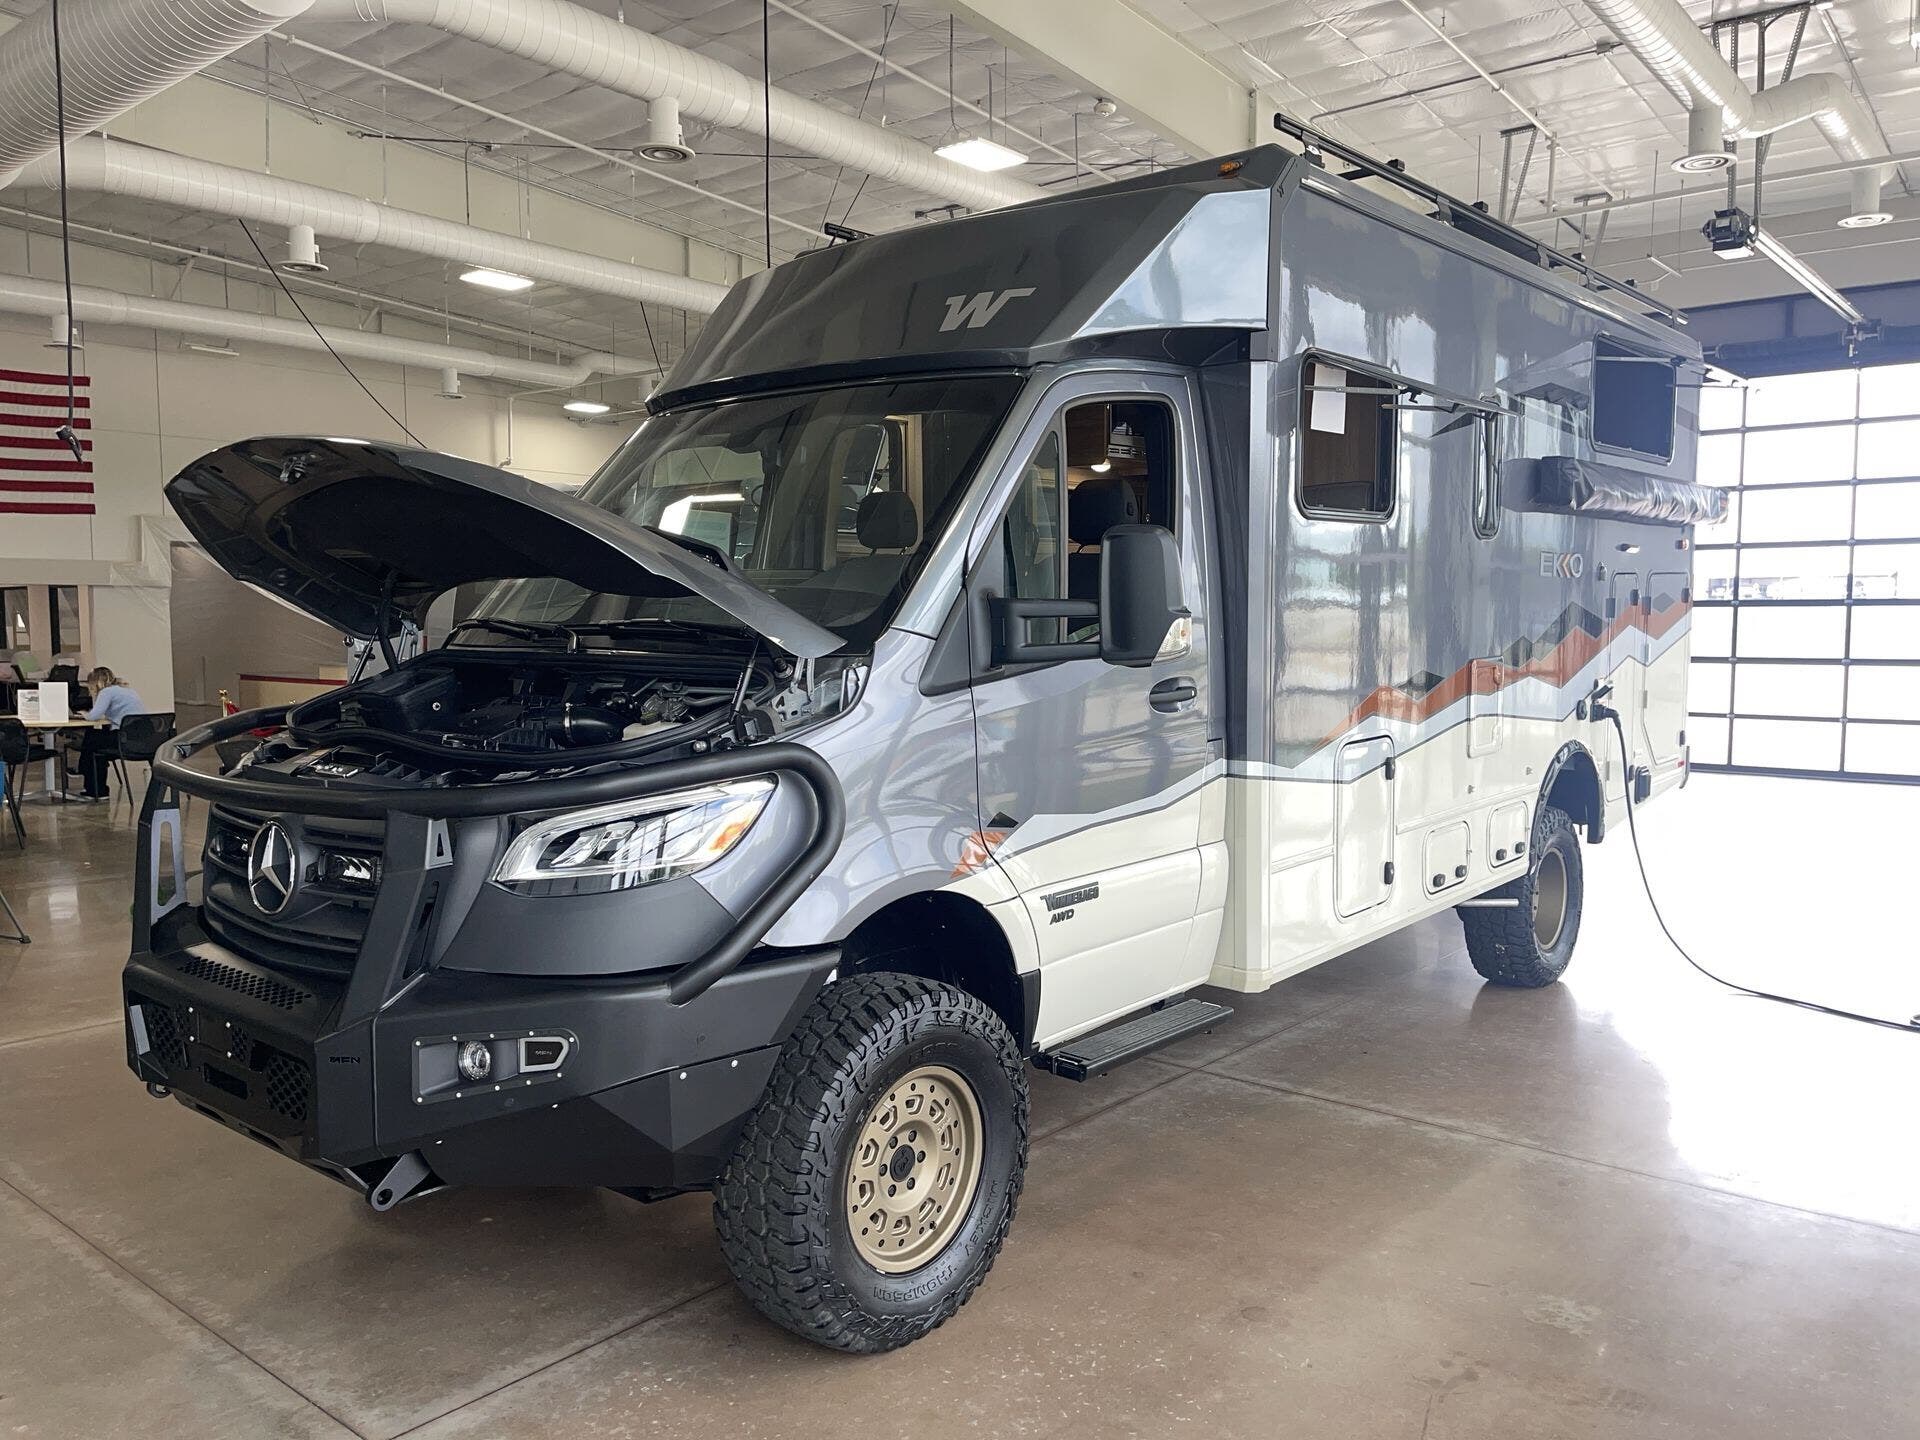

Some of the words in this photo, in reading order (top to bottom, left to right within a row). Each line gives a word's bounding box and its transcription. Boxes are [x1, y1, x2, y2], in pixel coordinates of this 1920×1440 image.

[1540, 552, 1584, 579] EKKO
[1049, 908, 1075, 925] AWD
[873, 1264, 958, 1303] THOMPSON
